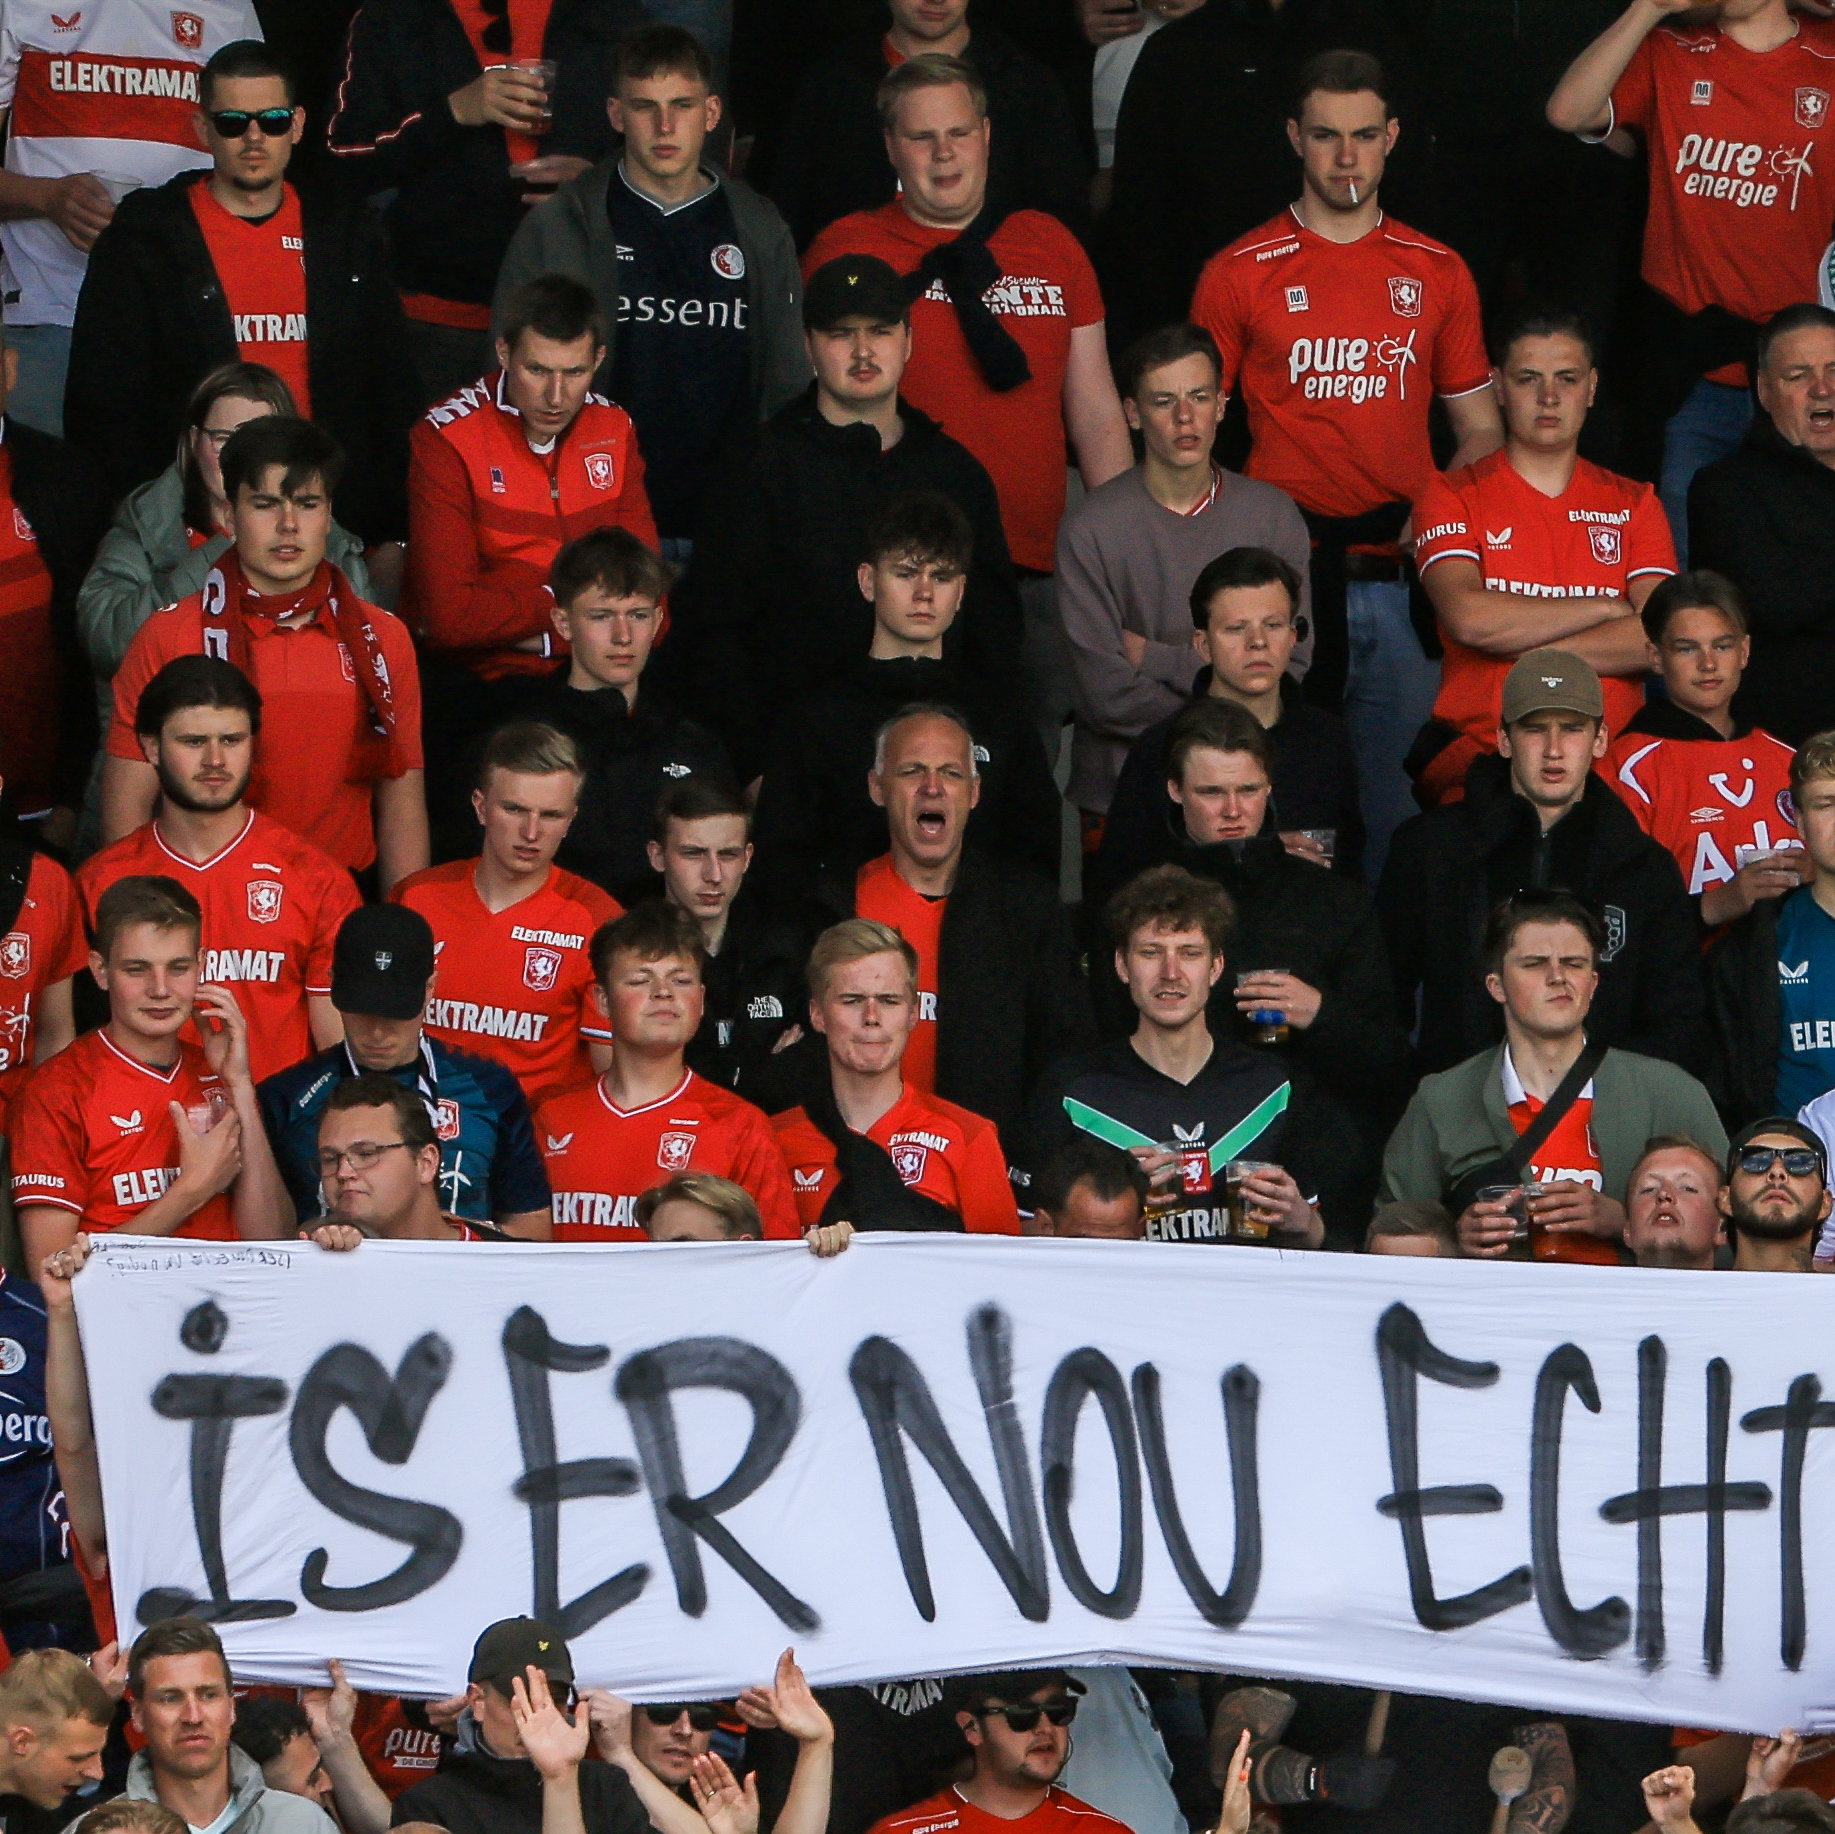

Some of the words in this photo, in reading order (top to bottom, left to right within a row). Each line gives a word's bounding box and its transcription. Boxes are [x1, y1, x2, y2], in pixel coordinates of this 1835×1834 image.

[1675, 133, 1761, 176] pure
[1684, 172, 1778, 208] energie
[1289, 337, 1349, 384] pure
[1304, 374, 1387, 404] energie
[1568, 509, 1632, 527] ELEKTRAMAT
[510, 925, 586, 950] ELEKTRAMAT
[420, 998, 550, 1043] EKTRAMAT
[1143, 1207, 1231, 1241] EKTRA
[501, 1304, 820, 1641] ER
[849, 1304, 1261, 1630] NOU
